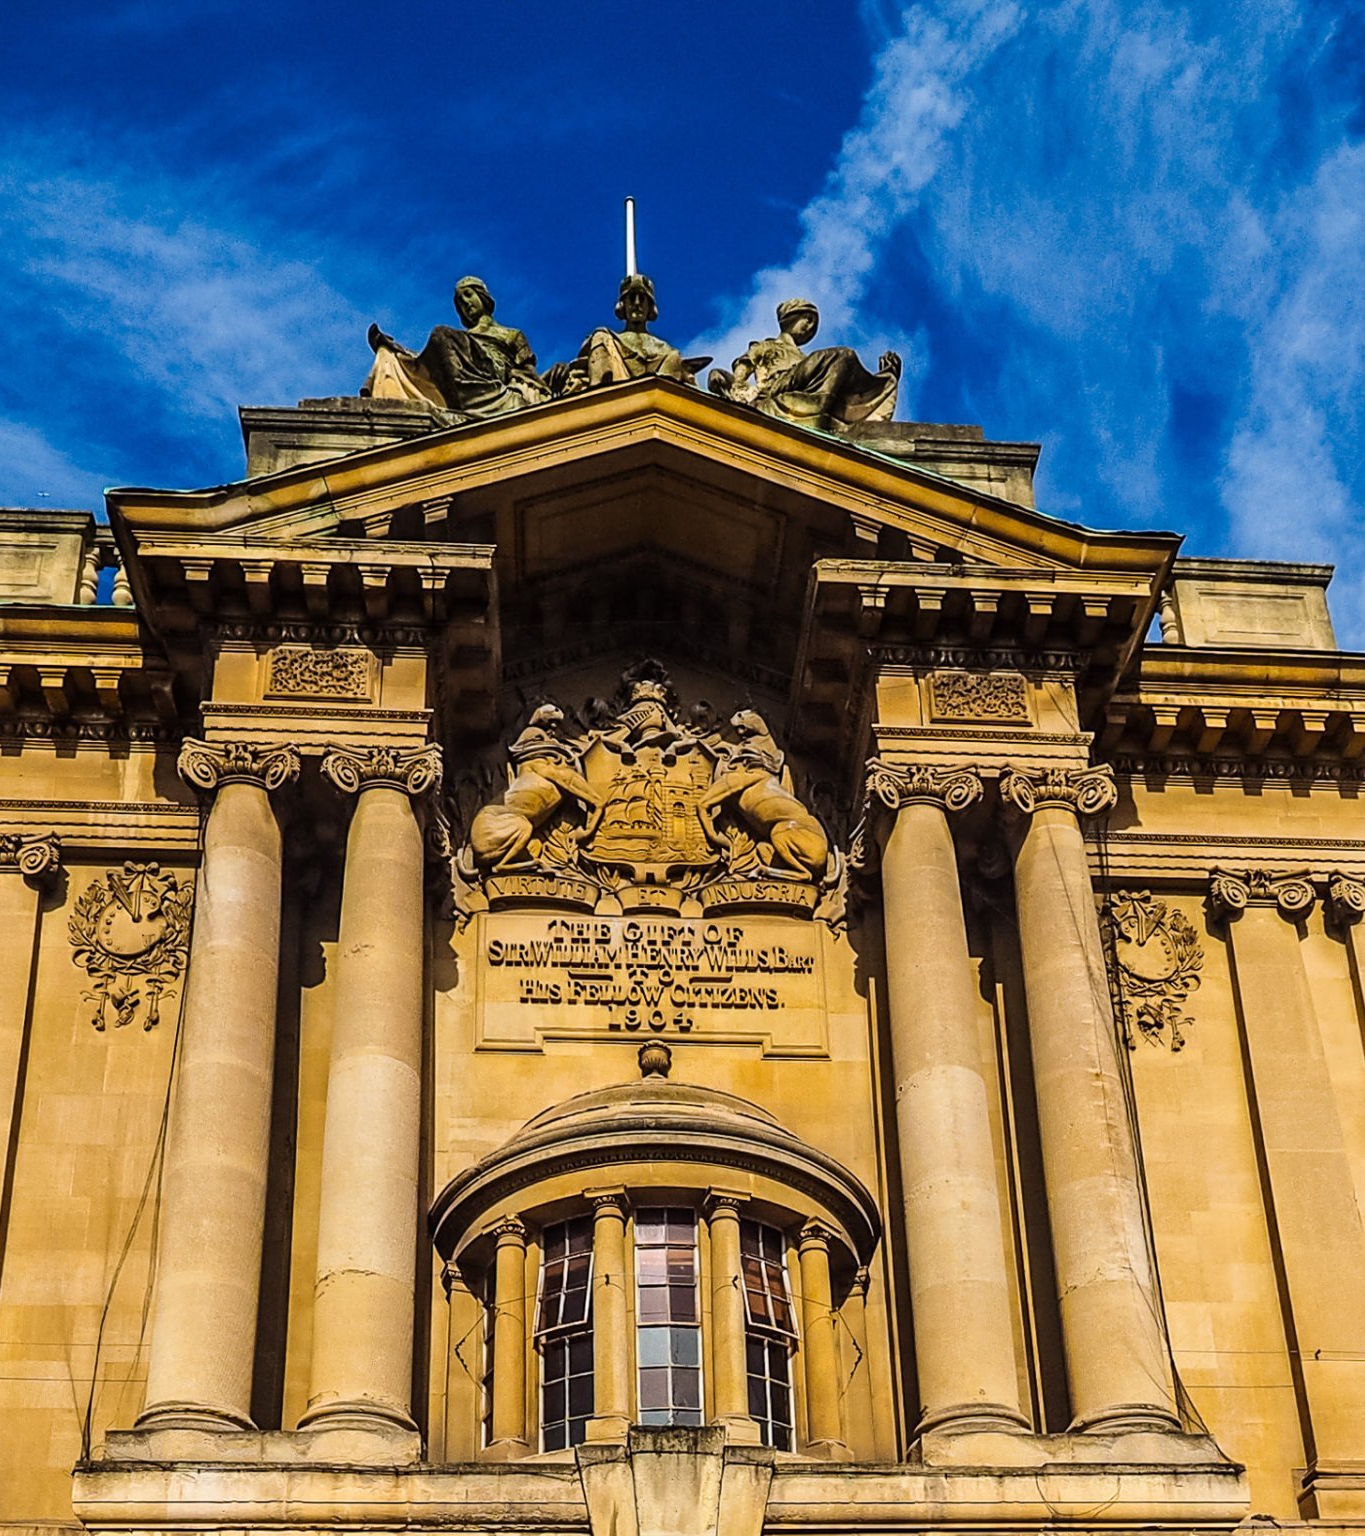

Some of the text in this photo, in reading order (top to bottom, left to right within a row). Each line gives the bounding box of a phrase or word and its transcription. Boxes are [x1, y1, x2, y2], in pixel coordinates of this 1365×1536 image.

[489, 879, 809, 906] VIRTUTE ET INDUSTRIA
[548, 920, 744, 948] THE GIFT OF
[488, 939, 532, 967] SIR
[531, 940, 622, 969] WILLIAM
[625, 942, 703, 972] HENRY
[629, 967, 674, 987] TO
[519, 980, 562, 1005] HIS
[568, 981, 664, 1007] FELLOW
